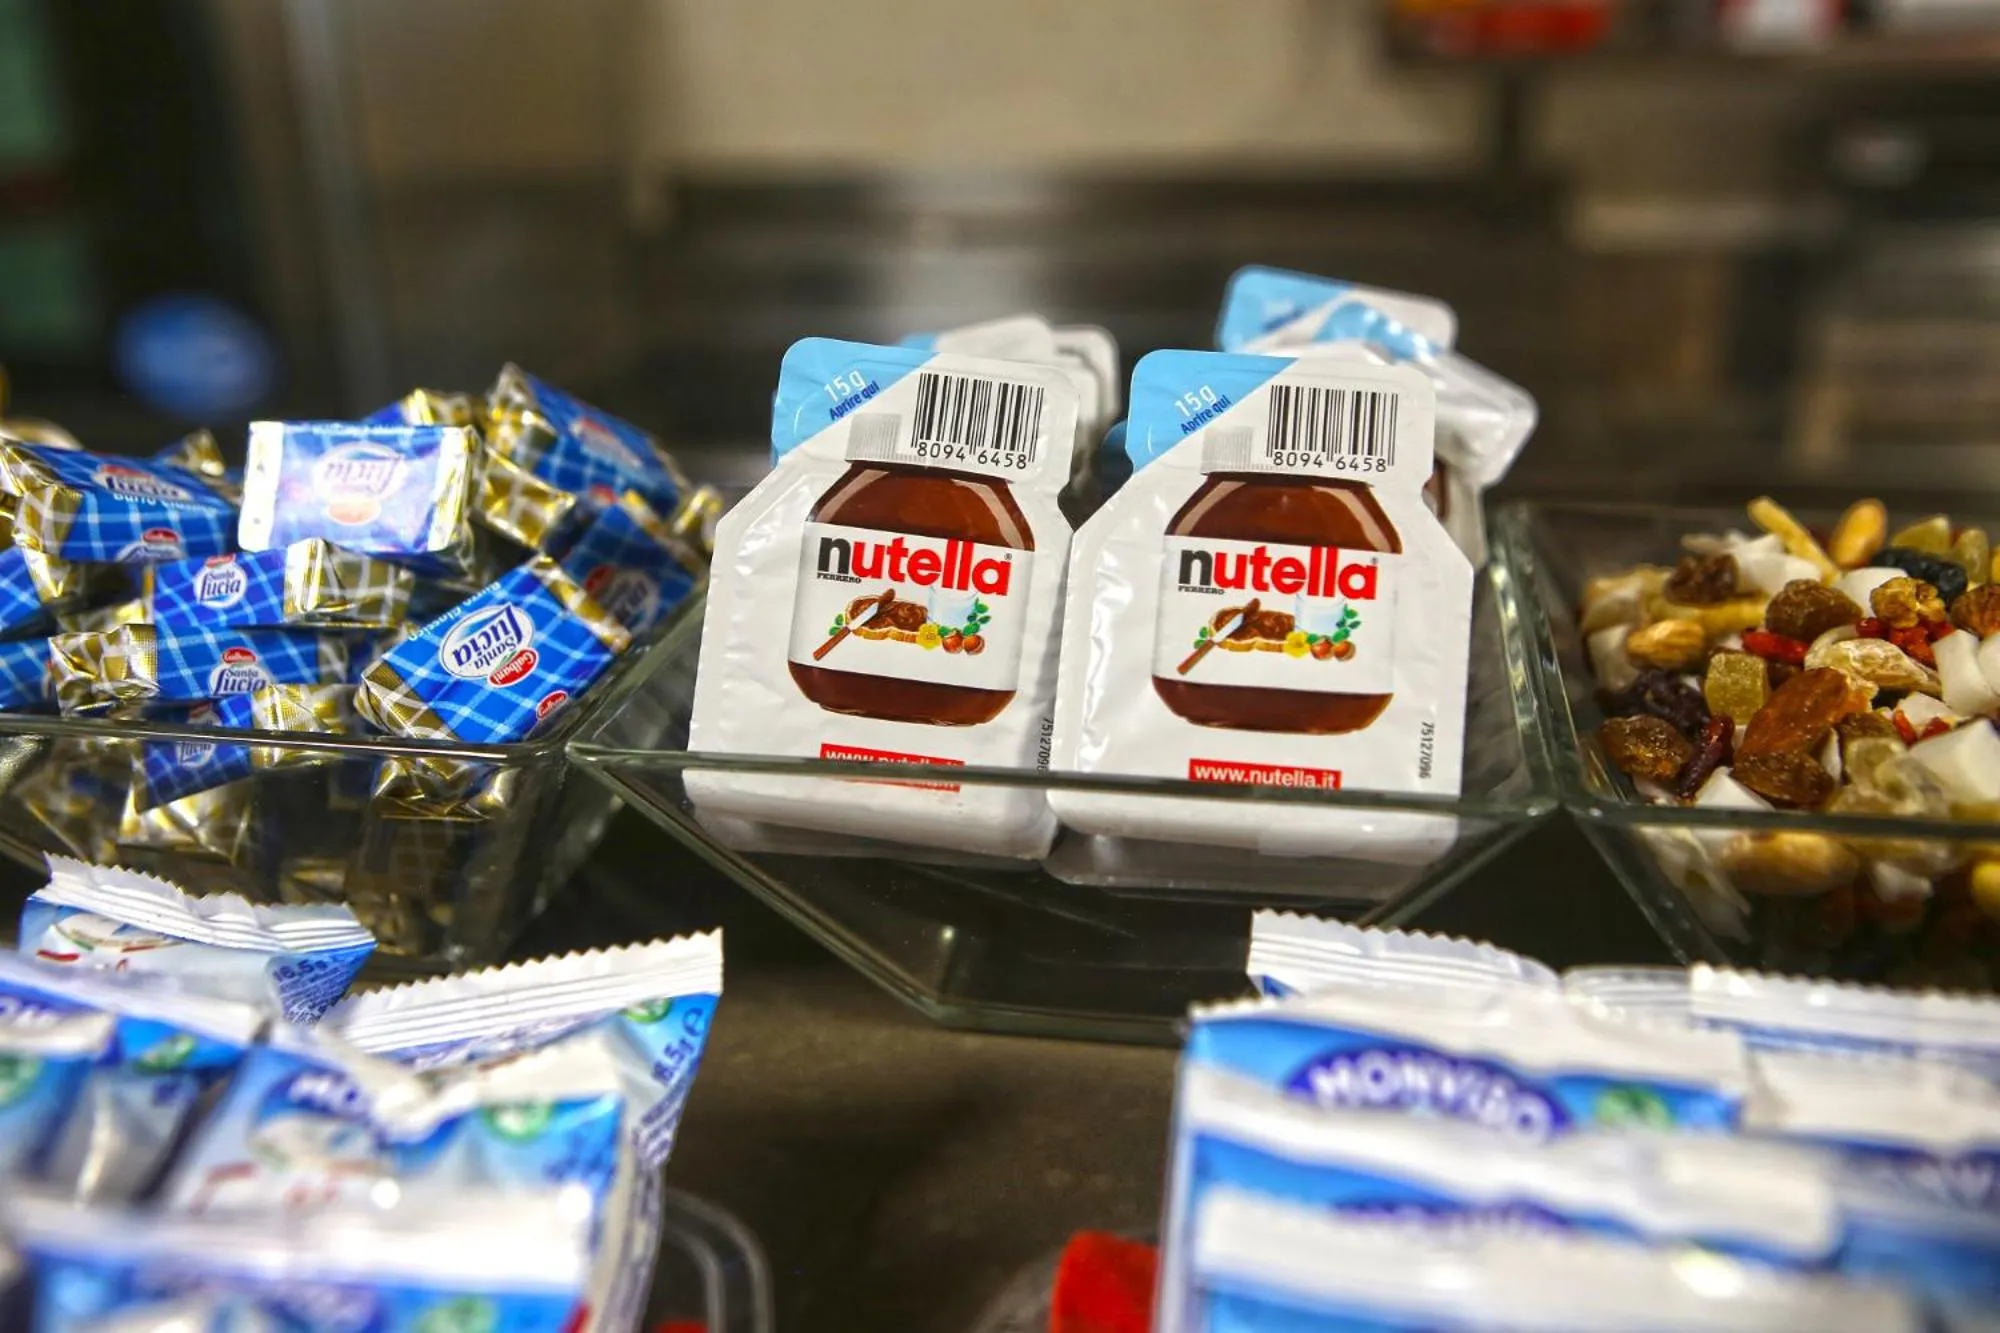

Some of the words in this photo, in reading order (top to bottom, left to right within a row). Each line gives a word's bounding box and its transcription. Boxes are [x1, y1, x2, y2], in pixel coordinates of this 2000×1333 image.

[829, 392, 863, 421] Aprire
[860, 380, 880, 400] qui
[1180, 407, 1214, 434] Aprire
[1212, 394, 1232, 414] qui
[917, 442, 966, 461] 8094
[977, 452, 1028, 470] 6458
[1272, 451, 1324, 468] 8094
[1336, 454, 1387, 473] 6458
[817, 537, 1012, 597] nutella
[817, 572, 862, 584] FERRERO
[1179, 544, 1378, 601] nutella
[474, 636, 517, 670] Santa
[493, 652, 534, 684] Galbani
[1192, 764, 1337, 790] www.nutella.it
